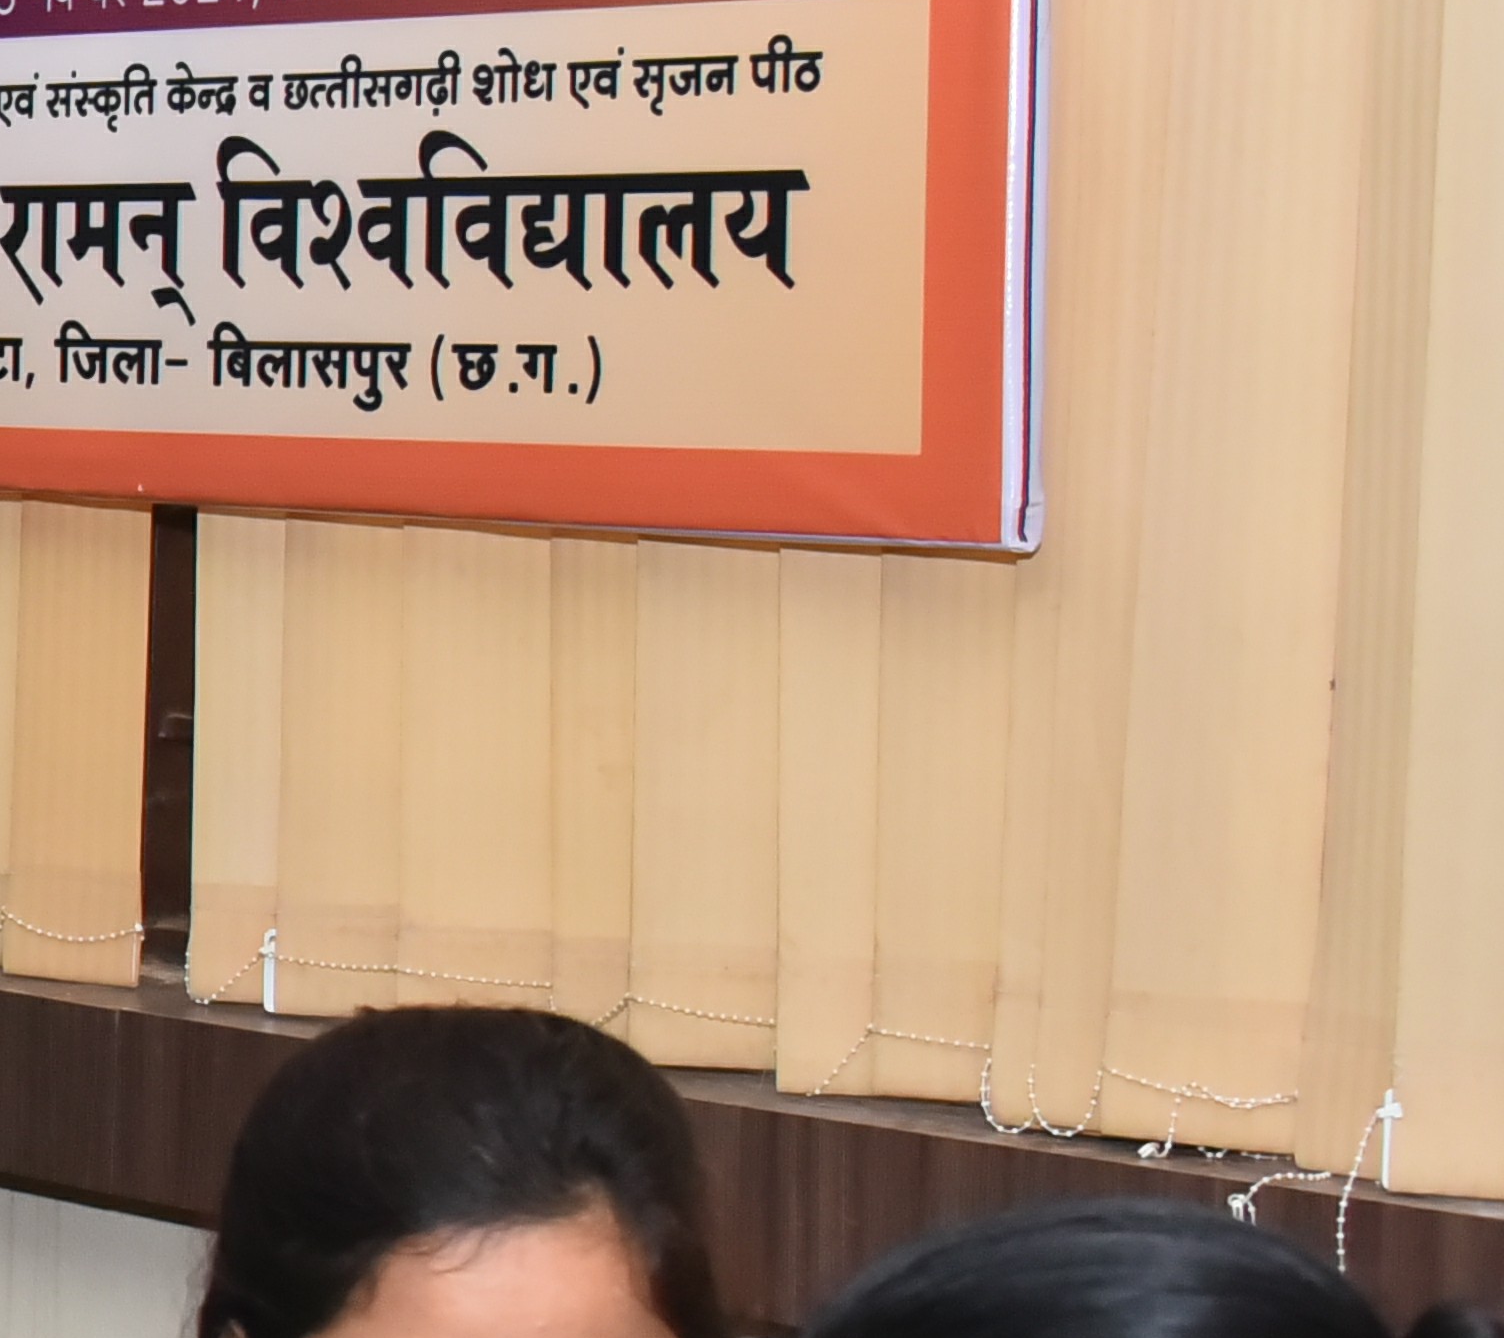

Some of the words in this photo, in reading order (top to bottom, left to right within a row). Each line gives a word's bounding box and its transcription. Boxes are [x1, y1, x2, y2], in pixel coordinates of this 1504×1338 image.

[46, 63, 156, 132] संस्कृति
[166, 61, 237, 117] केन्द्र
[248, 73, 273, 112] व
[283, 49, 461, 117] छत्तीसगढ़ी
[471, 48, 556, 105] शोध
[567, 46, 624, 110] एवं
[633, 54, 738, 116] सृजन
[750, 34, 823, 94] पीठ
[217, 130, 810, 291] विश्वविद्यालय
[207, 321, 411, 412] बिलासपुर
